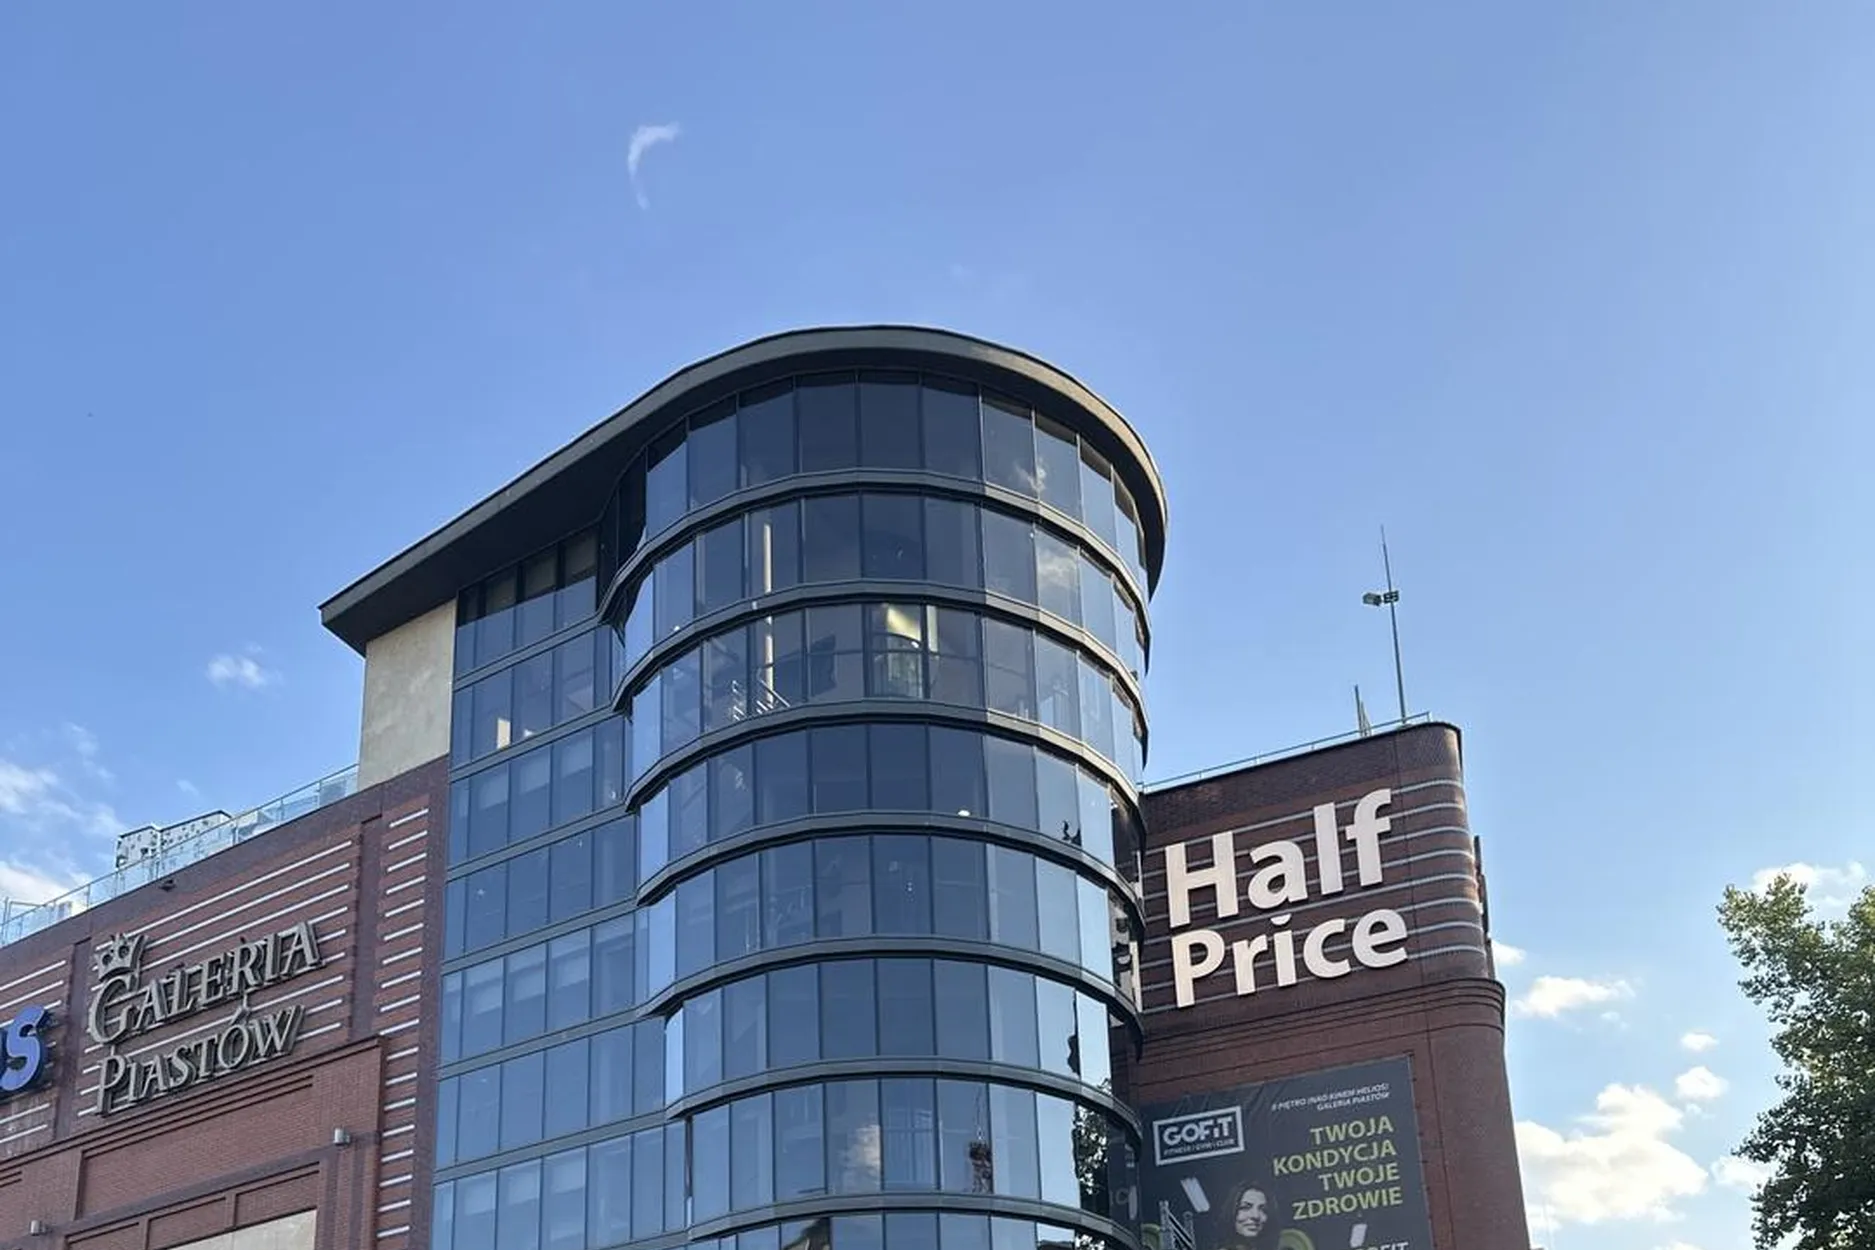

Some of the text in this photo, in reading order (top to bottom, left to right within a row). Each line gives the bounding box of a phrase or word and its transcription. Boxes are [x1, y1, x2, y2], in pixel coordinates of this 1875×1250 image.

[1165, 788, 1391, 928] Half
[88, 921, 322, 1045] GALERIA
[1172, 909, 1408, 1008] Price
[95, 1003, 304, 1117] PIASTÓW
[1273, 1139, 1397, 1176] KONDYCJA
[1310, 1115, 1394, 1145] TWOJA
[1292, 1186, 1403, 1220] ZDROWIE
[1318, 1163, 1400, 1191] TWOJE
